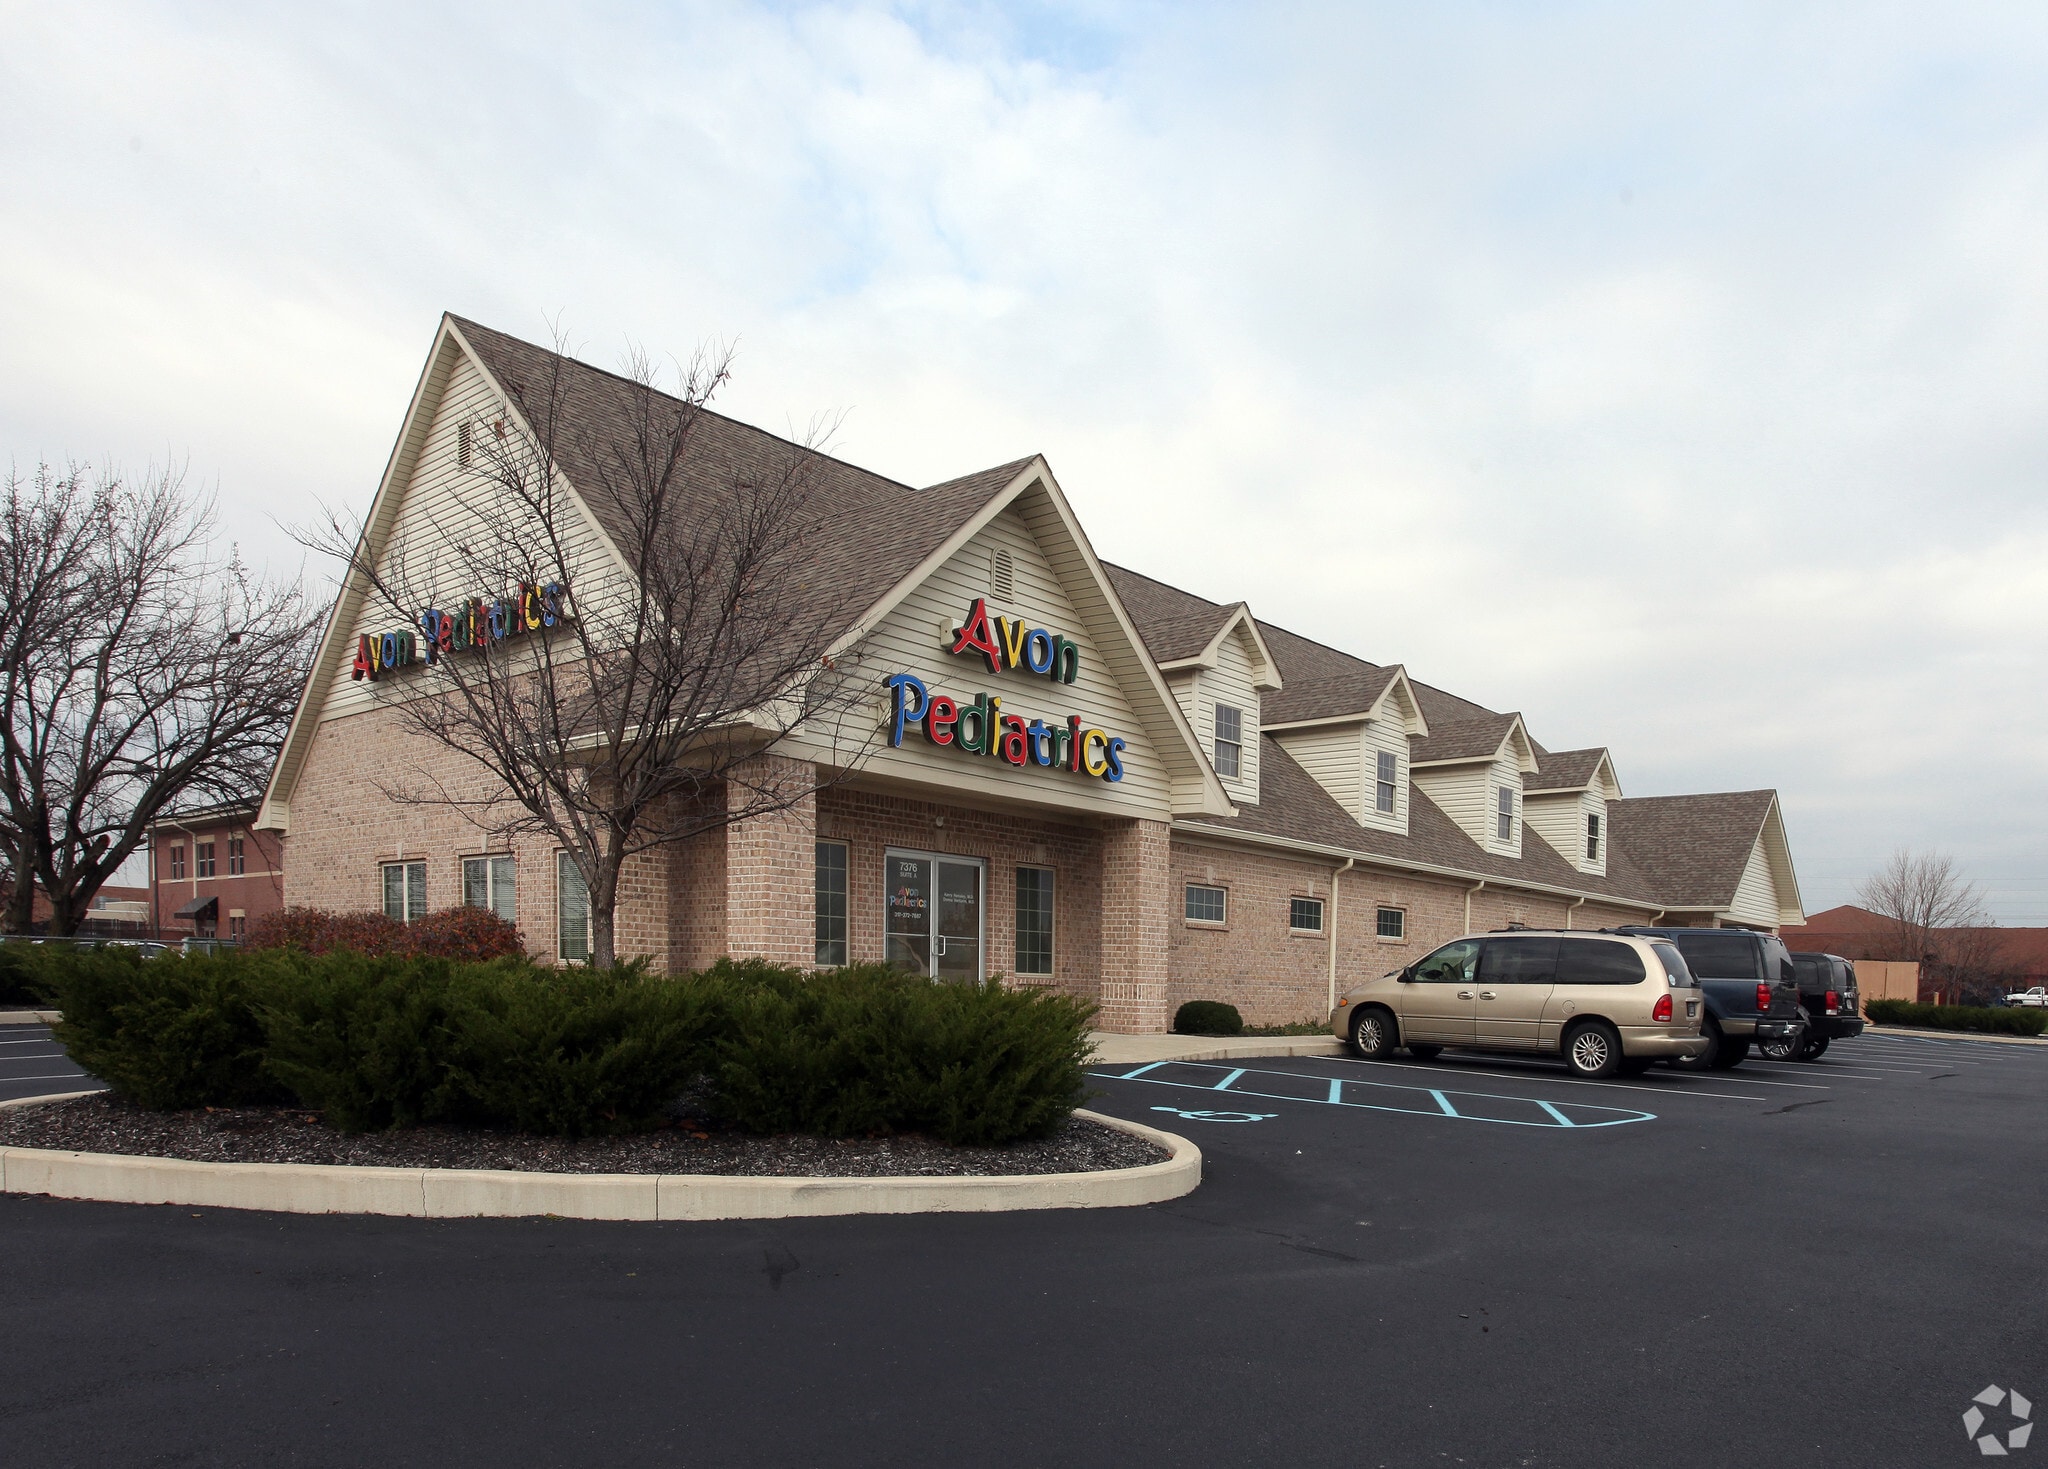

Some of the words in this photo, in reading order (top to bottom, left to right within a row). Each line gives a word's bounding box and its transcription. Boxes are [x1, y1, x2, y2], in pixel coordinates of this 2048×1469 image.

[351, 628, 418, 682] Avon
[421, 582, 567, 666] Pediatrics
[951, 597, 1080, 684] Avon
[882, 673, 1127, 783] Pediatrics
[898, 887, 919, 896] Avon
[900, 861, 918, 872] 7376
[889, 895, 927, 908] Pediatrics
